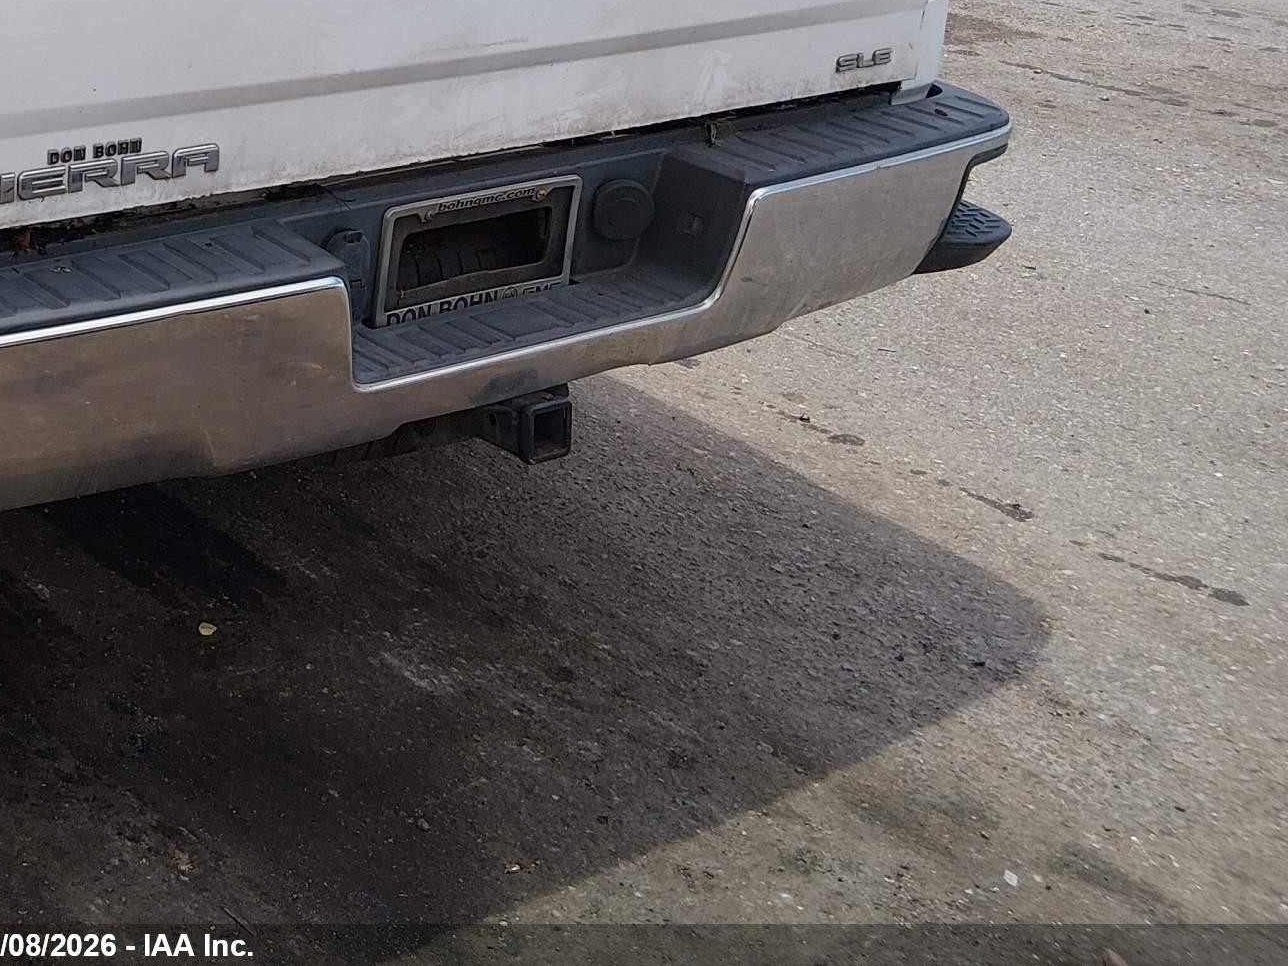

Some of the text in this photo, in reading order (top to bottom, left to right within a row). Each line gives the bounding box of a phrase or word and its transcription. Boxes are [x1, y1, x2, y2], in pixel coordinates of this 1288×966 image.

[836, 47, 893, 73] SLE
[47, 137, 143, 165] DON BOHN
